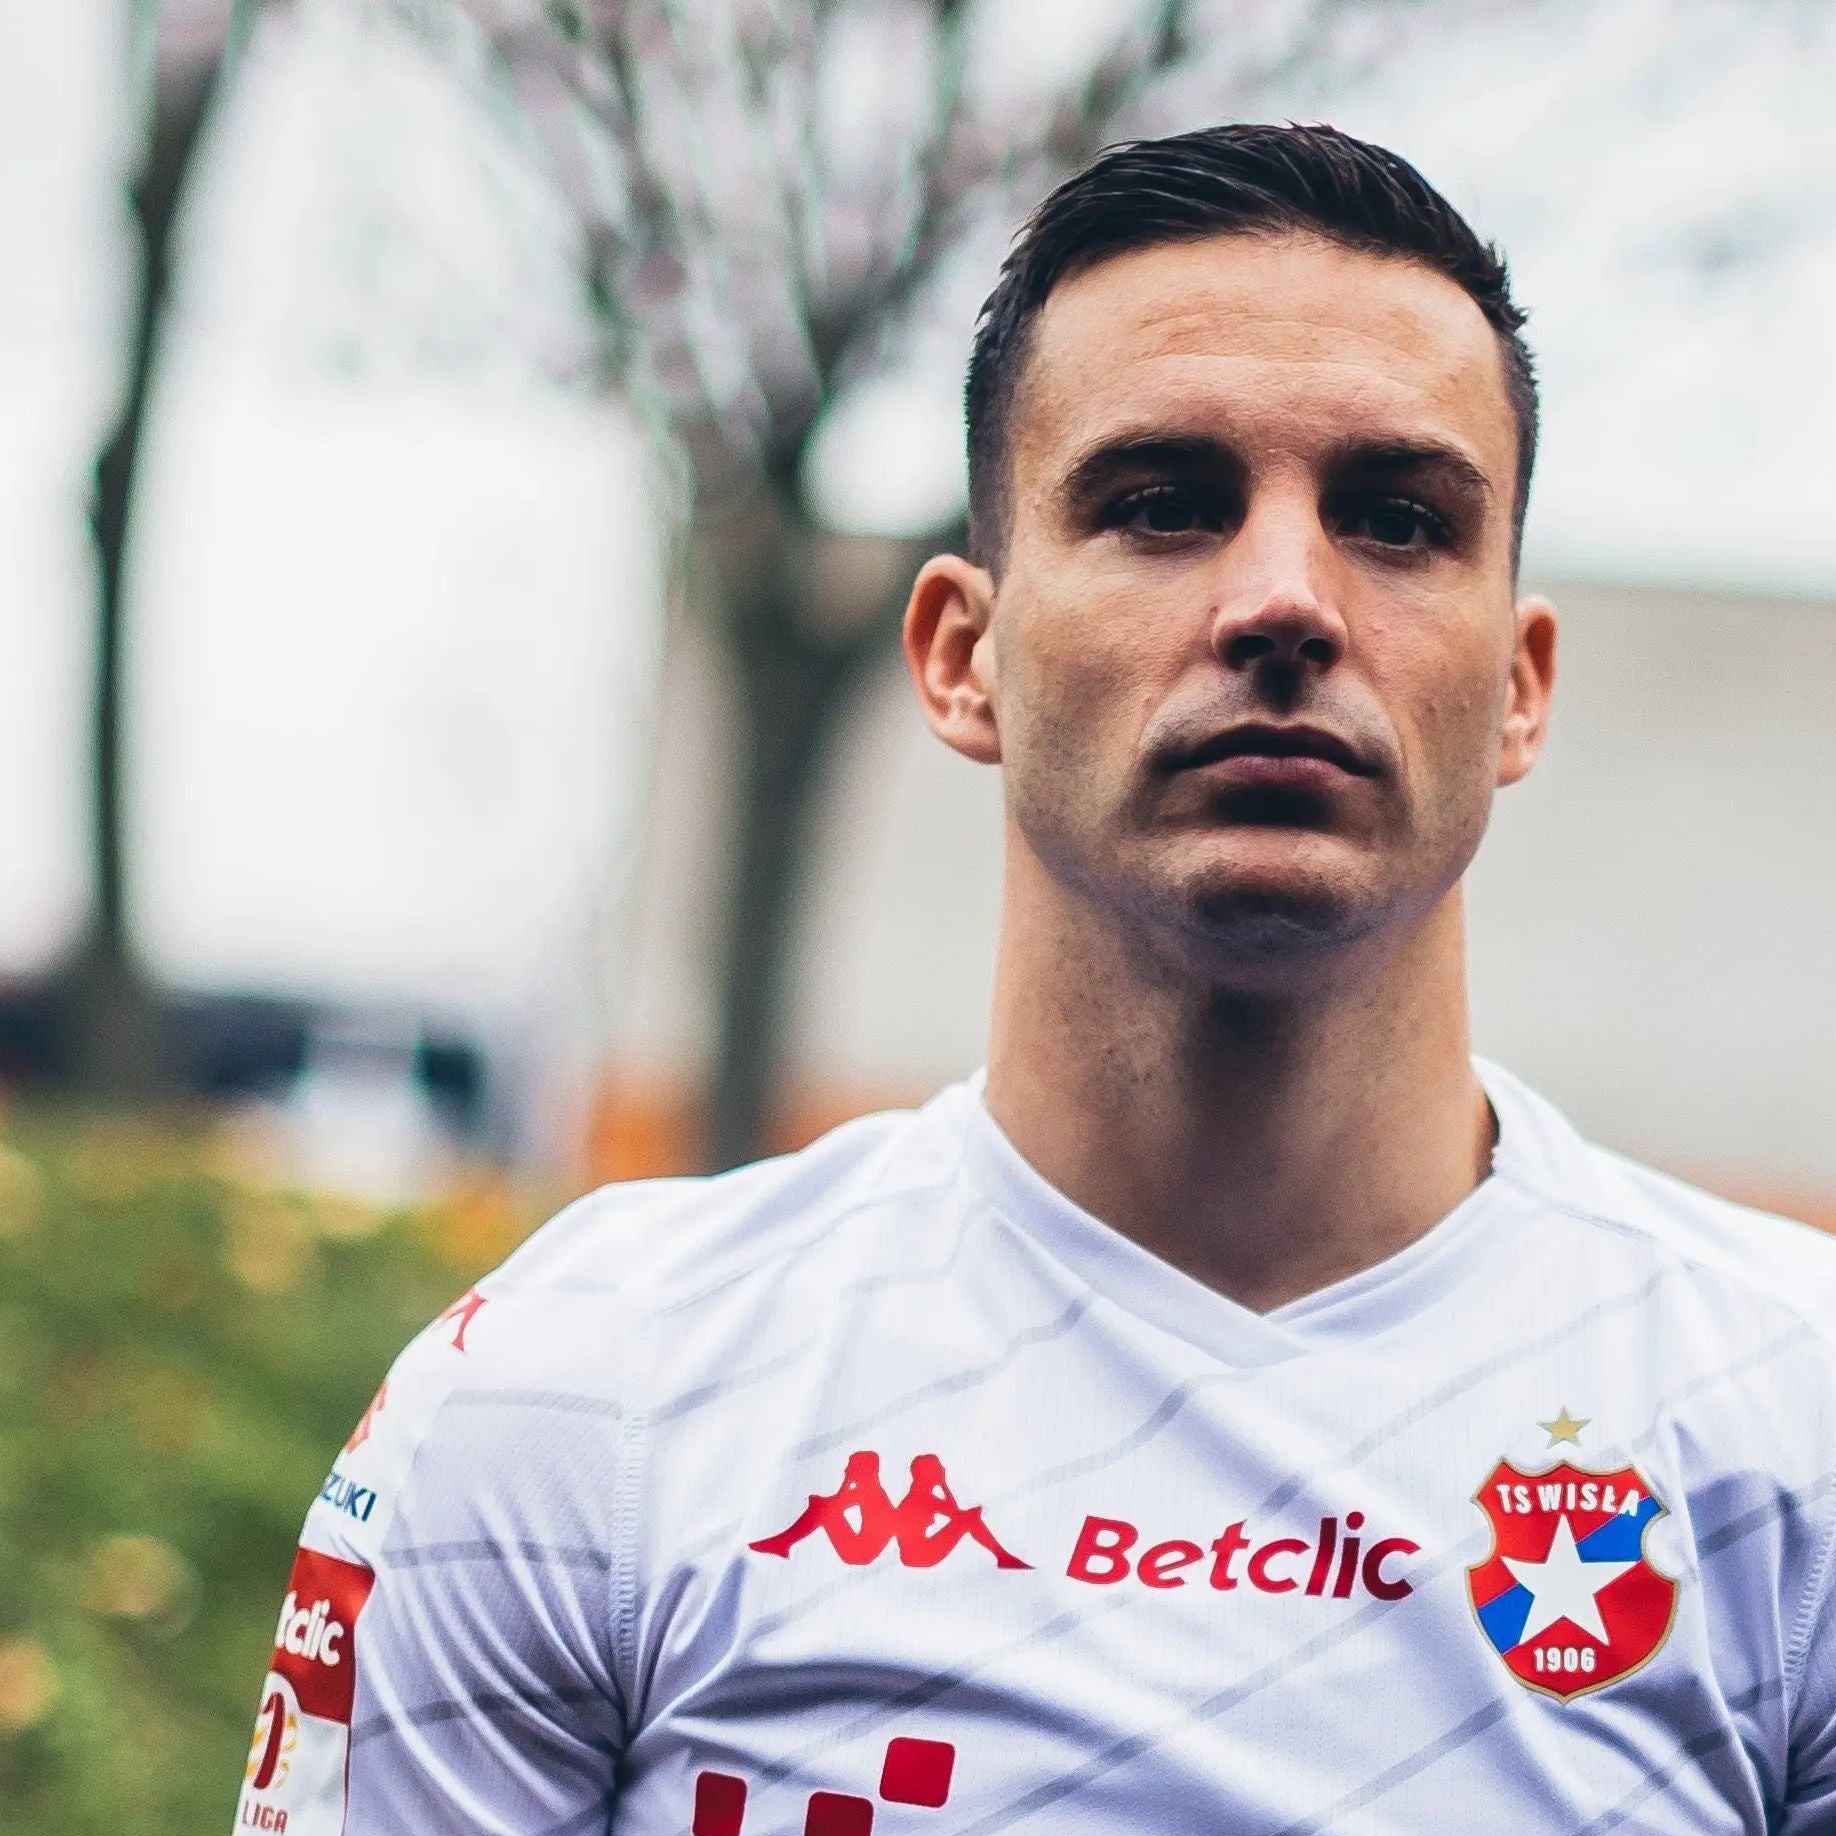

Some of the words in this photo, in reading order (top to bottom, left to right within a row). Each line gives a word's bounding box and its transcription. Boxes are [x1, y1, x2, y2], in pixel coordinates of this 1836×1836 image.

[1496, 1484, 1533, 1515] TS
[1537, 1484, 1641, 1517] WISŁA
[1066, 1510, 1422, 1601] Betclic
[1534, 1648, 1596, 1672] 1906
[242, 1800, 289, 1835] LIGA
